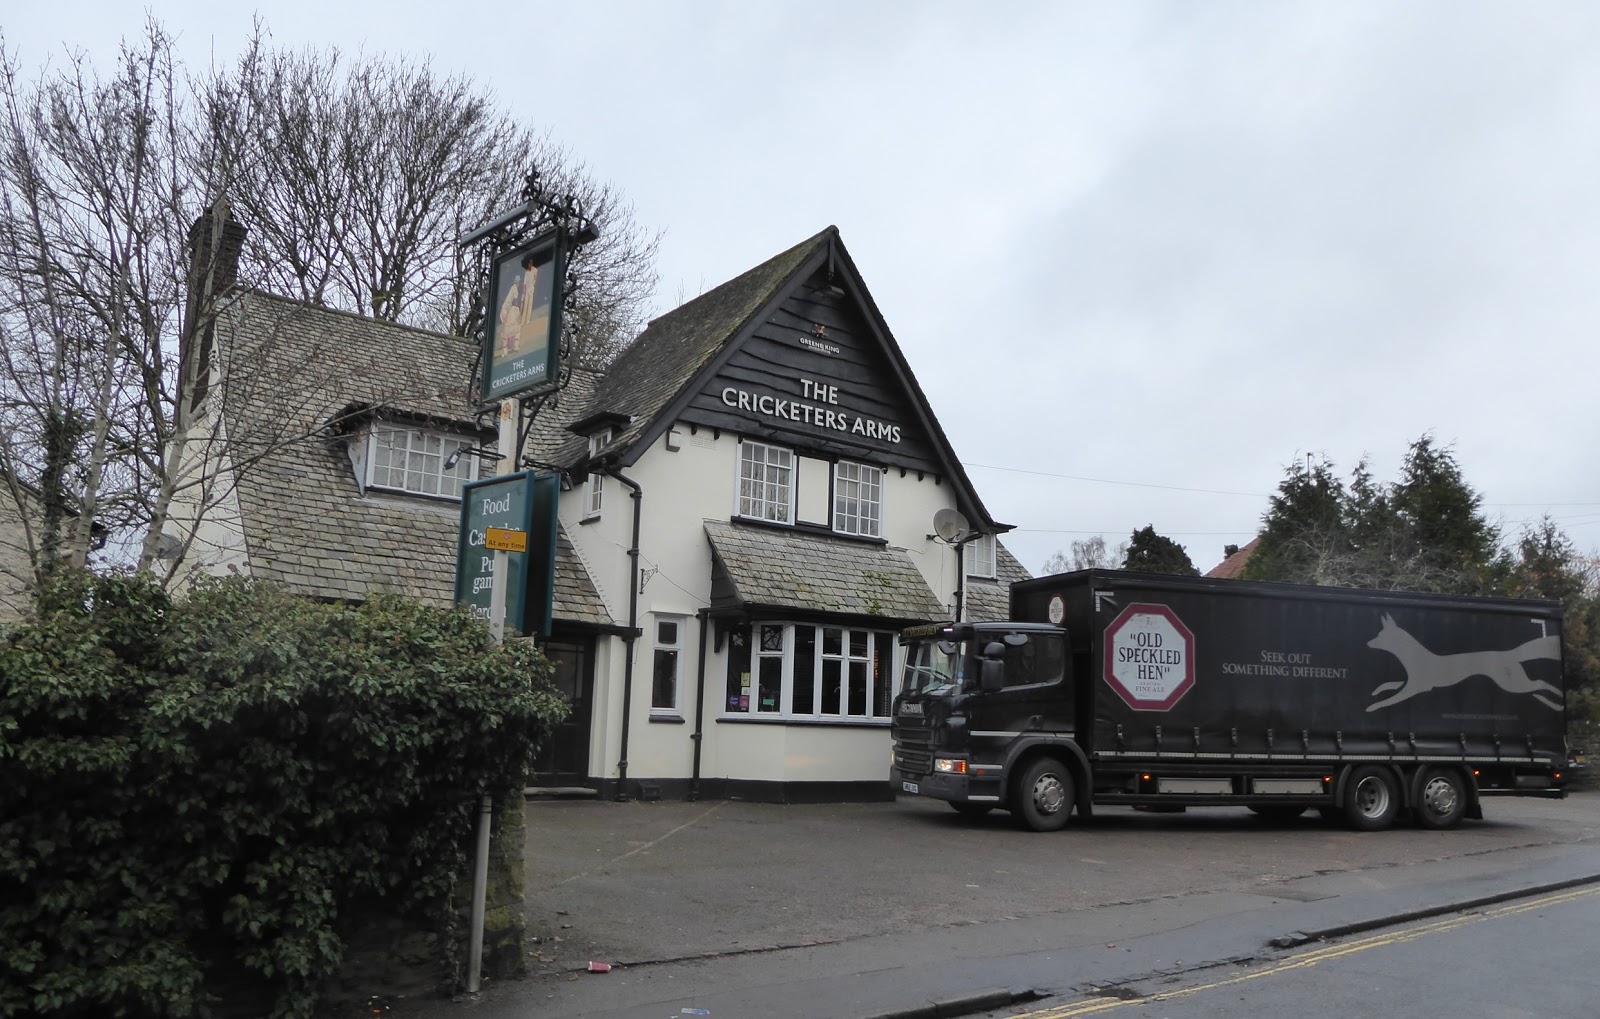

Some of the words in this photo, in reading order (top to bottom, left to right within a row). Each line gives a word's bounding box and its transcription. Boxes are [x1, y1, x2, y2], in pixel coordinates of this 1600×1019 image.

[512, 360, 525, 371] THE
[492, 369, 527, 389] CRICKETERS
[527, 363, 545, 377] ARMS
[800, 378, 839, 405] THE
[722, 387, 847, 431] CRICKETERS
[851, 417, 901, 444] ARMS
[482, 493, 510, 515] Food
[510, 541, 525, 549] time
[480, 556, 494, 572] Pu
[1118, 647, 1181, 665] SPECKLED
[1261, 650, 1286, 663] SEEK
[1287, 653, 1311, 664] OUT
[1222, 662, 1289, 677] SOMETHING
[1292, 666, 1348, 679] DIFFERENT
